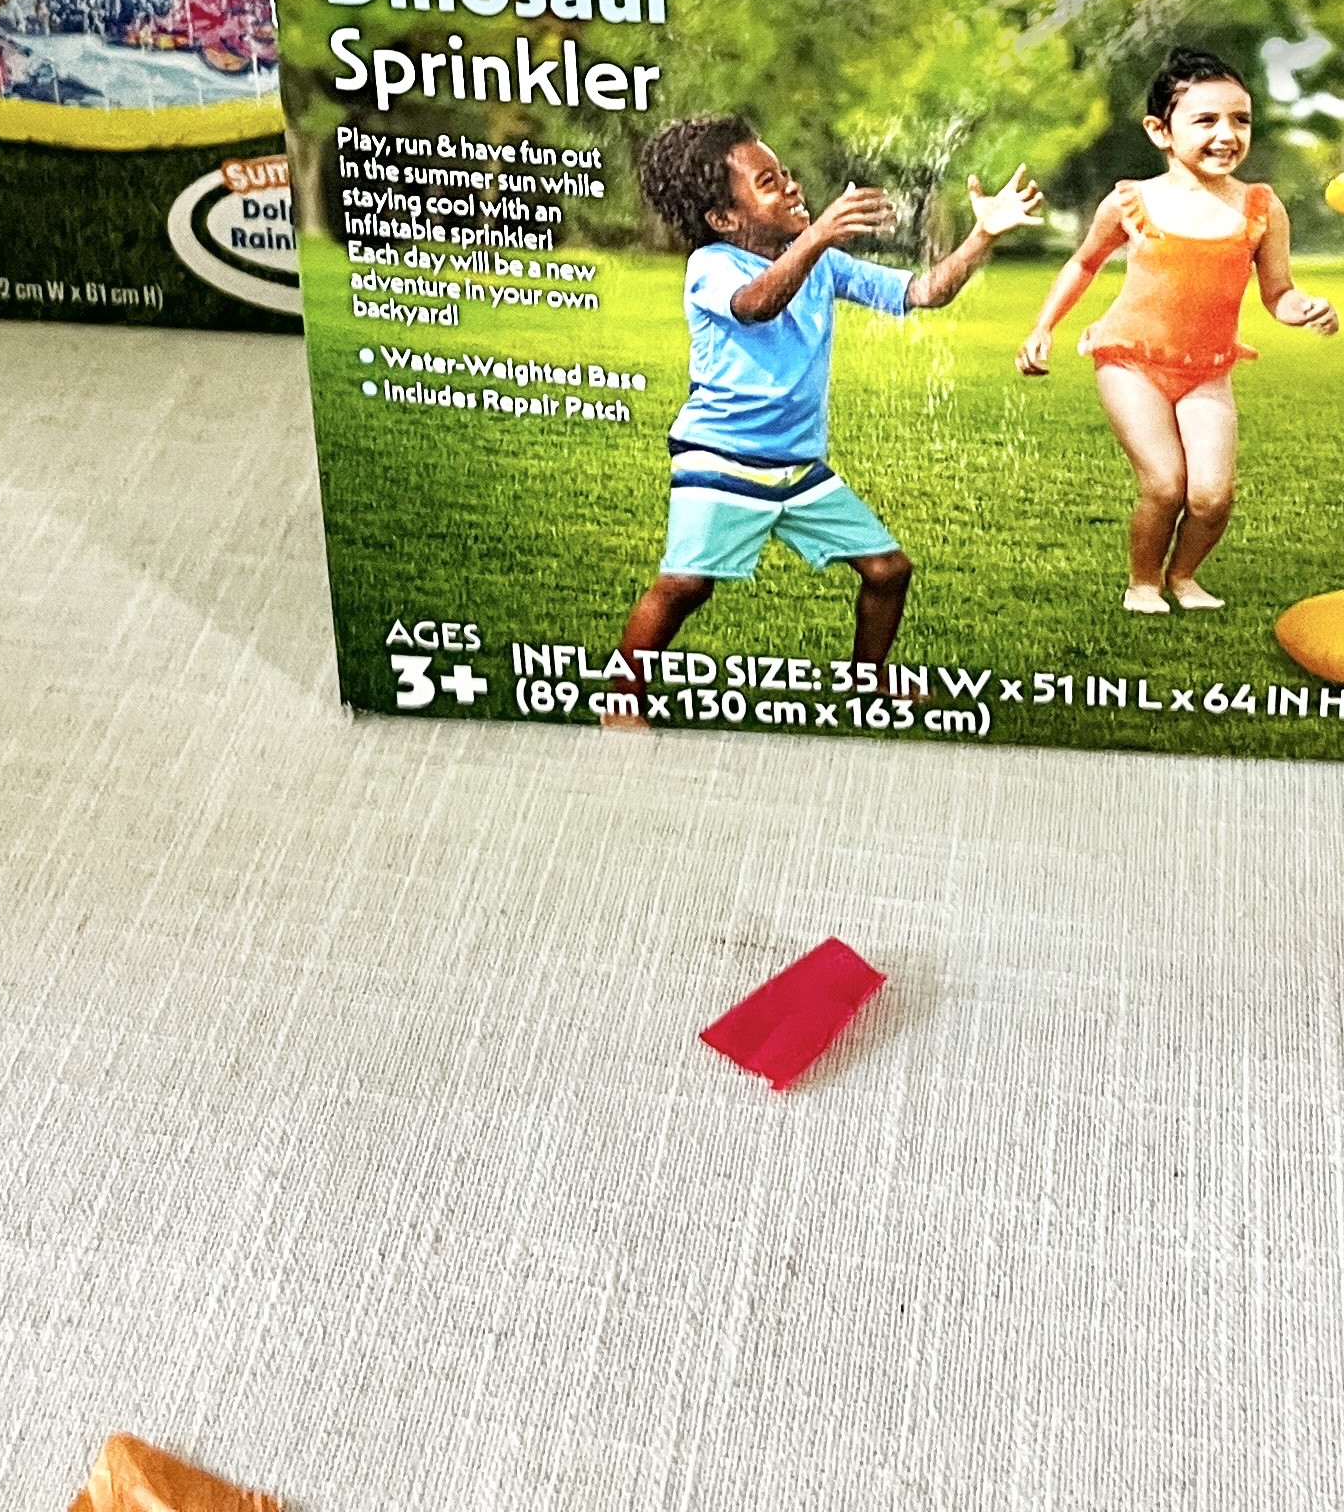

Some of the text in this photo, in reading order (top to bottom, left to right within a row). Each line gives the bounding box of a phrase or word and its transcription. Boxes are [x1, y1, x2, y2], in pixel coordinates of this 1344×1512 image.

[329, 27, 661, 112] Sprinkler
[337, 126, 602, 169] Play, run & have fun out
[363, 157, 400, 183] the
[404, 165, 494, 190] summer
[498, 172, 536, 193] sun
[540, 173, 605, 198] while
[242, 198, 294, 226] Dol
[342, 187, 562, 224] staying cool with an
[450, 223, 554, 251] sprinkler!
[347, 239, 597, 282] Each day will be a new
[350, 267, 599, 310] adventure in your own
[352, 294, 459, 327] backyard!
[379, 345, 647, 392] Water-Weighted Base
[383, 379, 630, 422] Includes Repair Patch
[385, 618, 482, 652] AGES
[389, 654, 489, 710] 3+
[511, 641, 717, 685] INFLATED
[726, 654, 823, 691] SIZE:
[830, 660, 878, 695] 35
[888, 663, 928, 697] IN
[937, 666, 993, 700] W
[998, 678, 1024, 703] x
[1033, 672, 1074, 705] 51
[1086, 674, 1128, 709] IN
[1138, 678, 1163, 710] L
[1169, 687, 1195, 713] x
[1203, 682, 1257, 715] 64
[1267, 684, 1309, 719] IN
[515, 677, 991, 736] (89 cm x 130 cm x 163 cm)
